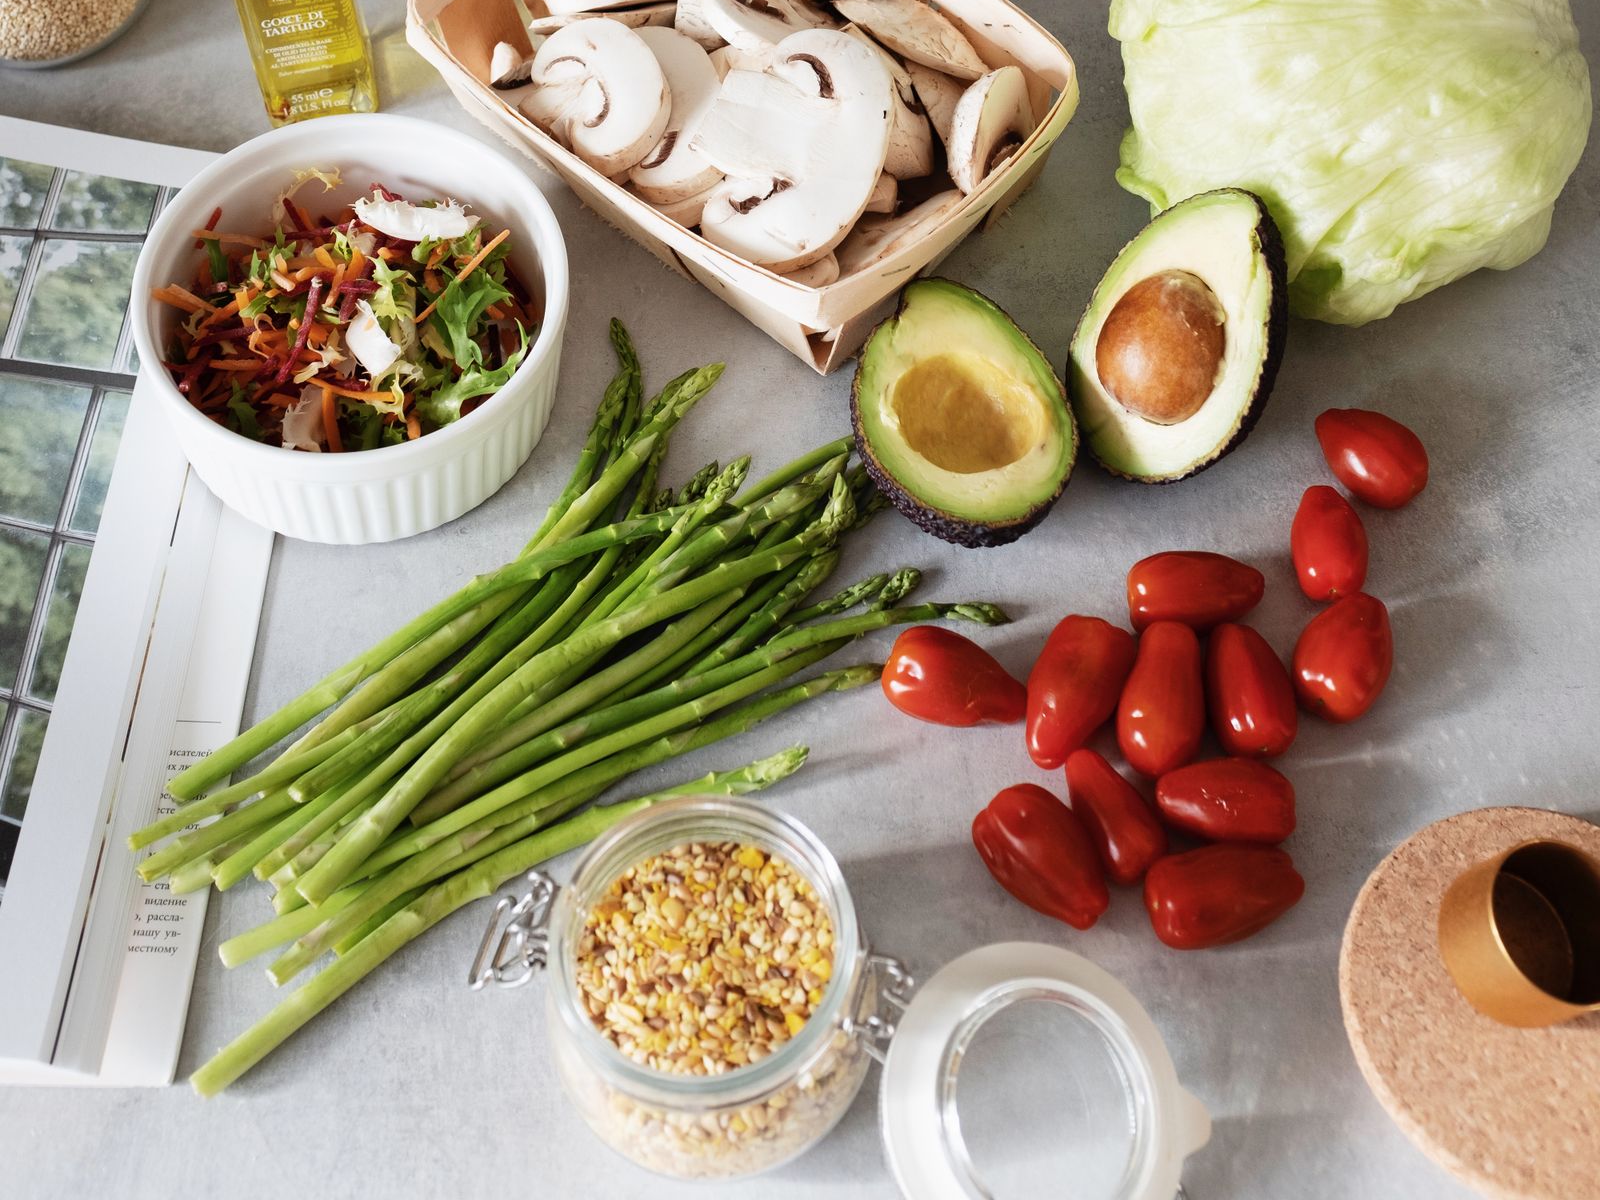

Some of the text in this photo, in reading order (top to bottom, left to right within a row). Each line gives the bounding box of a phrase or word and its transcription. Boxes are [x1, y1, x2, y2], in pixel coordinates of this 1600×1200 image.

[307, 10, 324, 21] DI
[291, 94, 304, 104] 55
[306, 91, 319, 100] ml
[144, 897, 188, 907] видение
[147, 913, 184, 923] рассла-
[132, 929, 181, 940] нашу ув-
